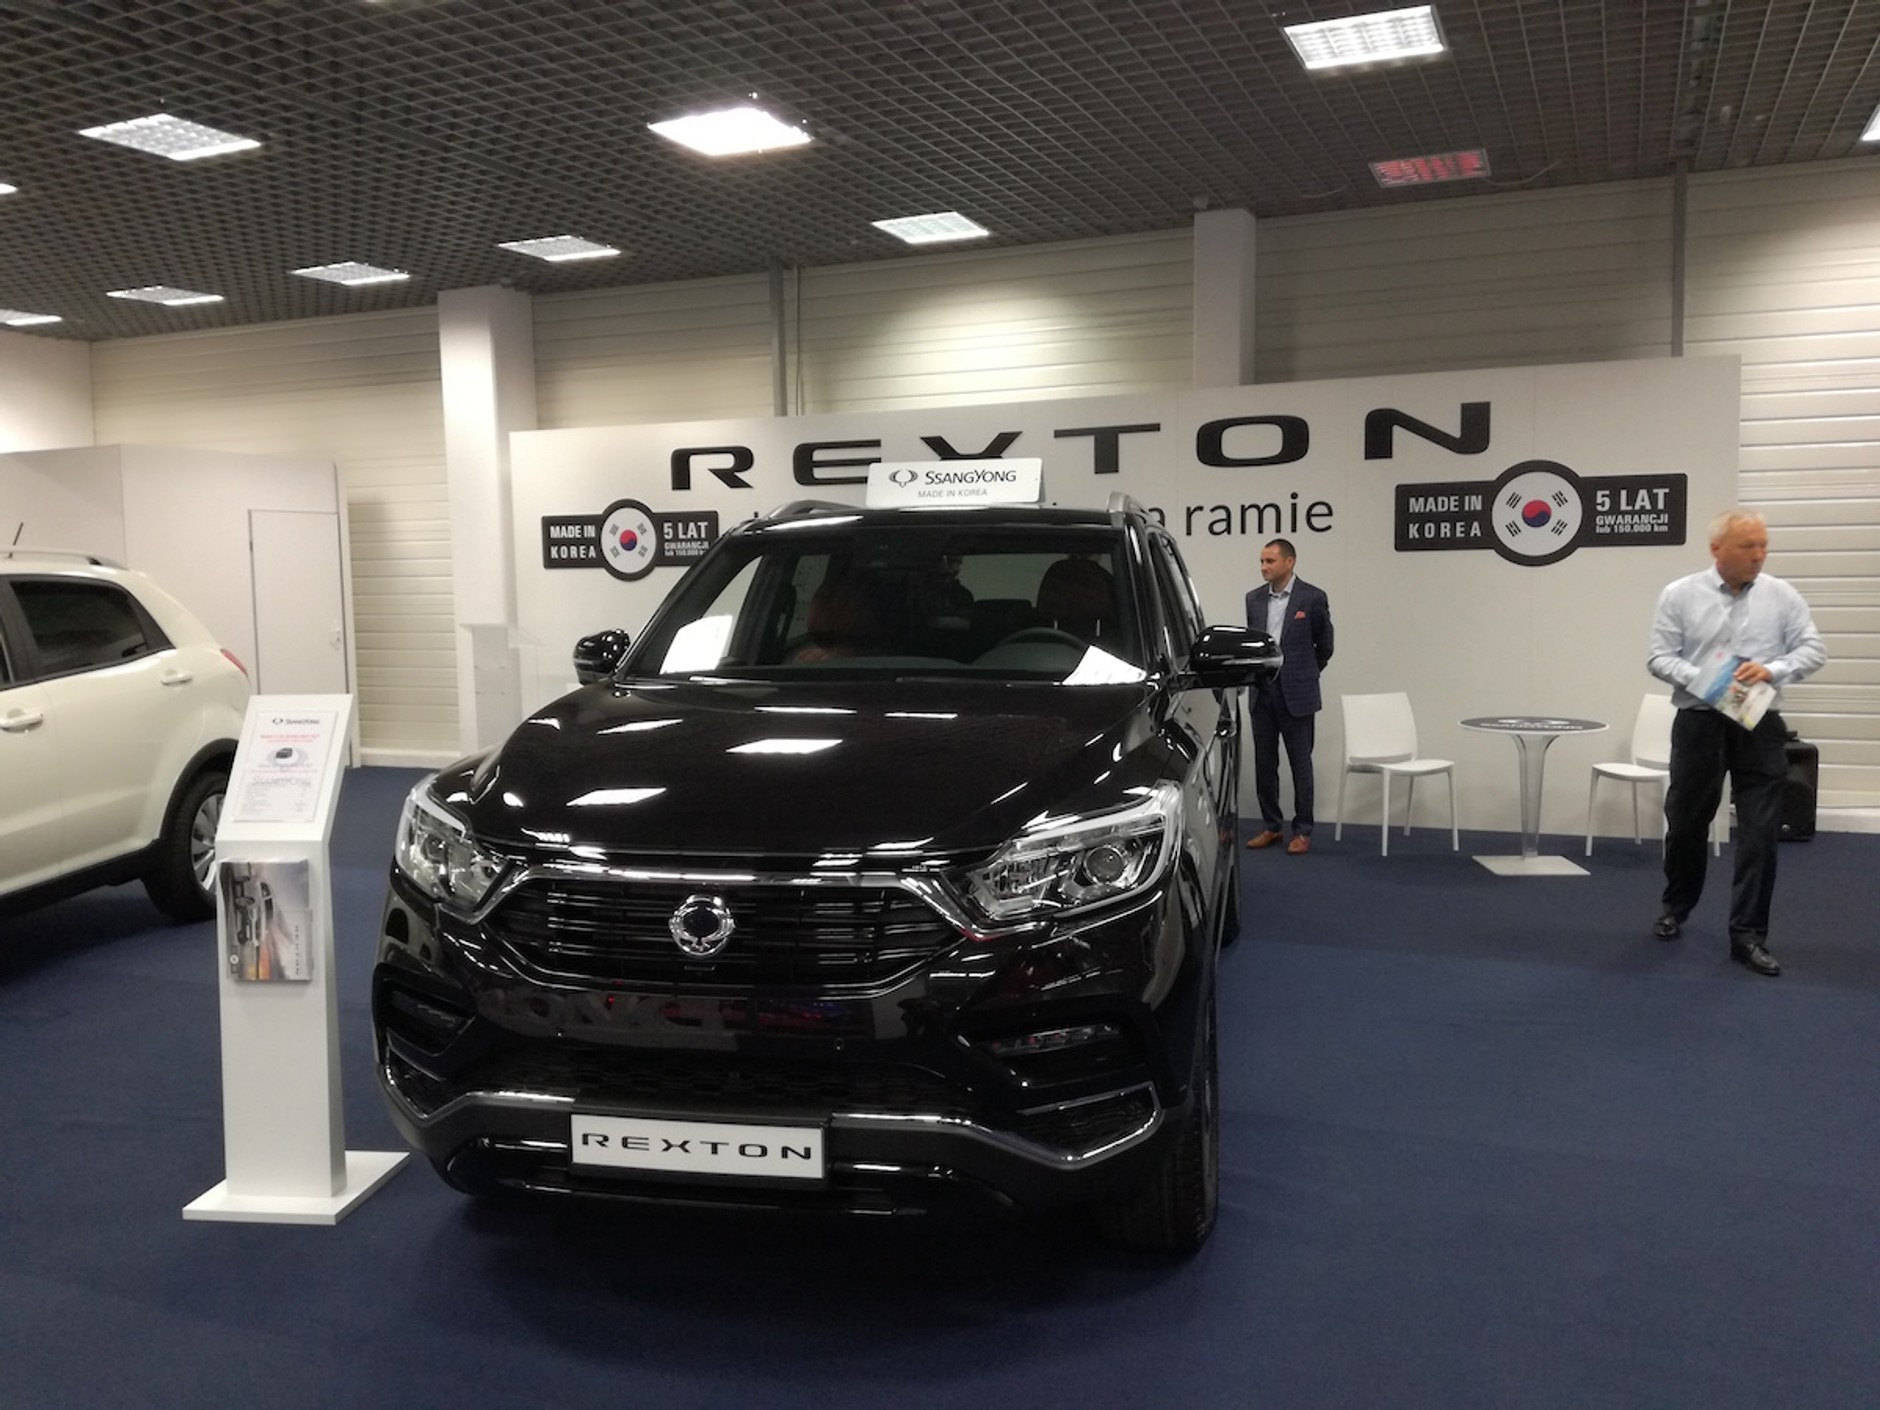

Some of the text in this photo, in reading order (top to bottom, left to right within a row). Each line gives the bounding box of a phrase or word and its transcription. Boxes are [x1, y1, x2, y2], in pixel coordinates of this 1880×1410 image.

[918, 488, 988, 498] MADE IN KOREA
[1595, 488, 1670, 511] 5 LAT
[1408, 495, 1482, 513] MADE IN
[1185, 491, 1334, 536] ramie
[1595, 513, 1669, 525] GWARANCJI
[550, 525, 596, 539] MADE IN
[663, 521, 709, 539] 5 LAT
[1408, 521, 1482, 539] KOREA
[1595, 524, 1611, 533] lub
[1653, 523, 1668, 532] km
[550, 545, 597, 559] KOREA
[581, 1132, 811, 1161] REXTON
